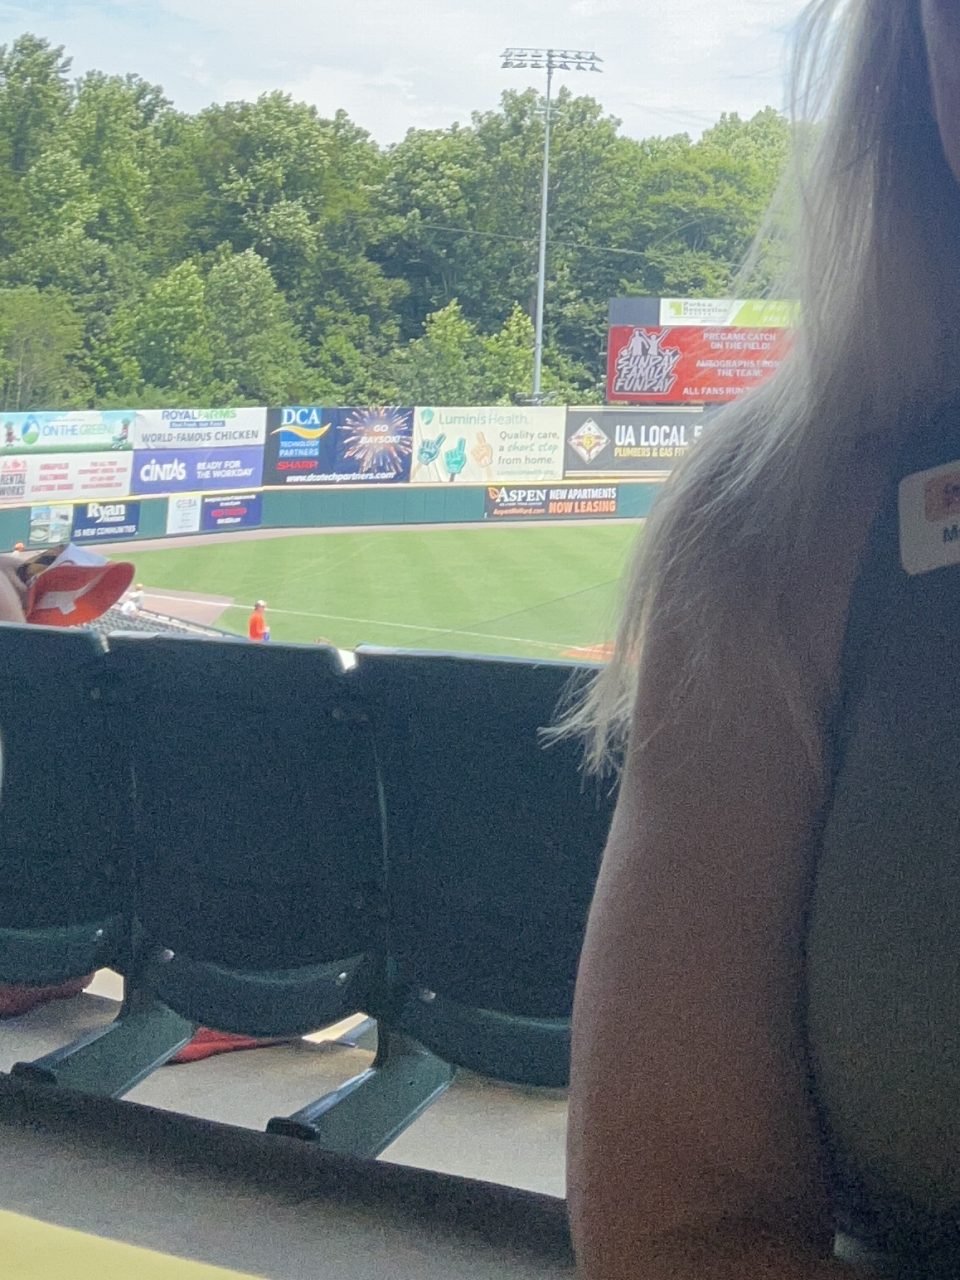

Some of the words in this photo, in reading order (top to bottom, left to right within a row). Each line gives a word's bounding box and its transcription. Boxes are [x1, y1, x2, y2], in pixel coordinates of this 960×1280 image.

[710, 342, 724, 350] ON
[725, 342, 743, 350] THE
[617, 354, 681, 369] SUNDAY
[619, 366, 674, 379] FAMILY
[717, 369, 734, 377] THE
[615, 377, 676, 392] FUNDAY
[682, 387, 700, 395] ALL
[701, 387, 724, 395] FANS
[161, 410, 198, 420] ROYAL
[198, 409, 237, 419] FARMS
[281, 408, 321, 425] DCA
[42, 425, 58, 436] ON
[60, 424, 78, 435] THE
[373, 424, 389, 432] GO
[141, 432, 212, 443] WORLD-FAMOUS
[214, 430, 259, 441] CHICKEN
[499, 431, 535, 441] Quality
[614, 425, 636, 446] UA
[640, 425, 688, 446] LOCAL
[280, 440, 320, 448] TECHNOLOGY
[279, 448, 319, 456] PARTNERS
[614, 447, 651, 457] PLUMBERS
[652, 448, 659, 457] &
[659, 447, 674, 457] GAS
[196, 461, 223, 471] READY
[224, 460, 242, 468] FOR
[275, 460, 319, 470] SHARP
[497, 455, 521, 465] from
[212, 468, 255, 478] WORKDAY
[496, 487, 547, 502] ASPEN
[549, 489, 567, 500] NEW
[568, 488, 617, 499] APARTMENTS
[549, 502, 573, 513] NOW
[574, 500, 616, 512] LEASING
[87, 502, 126, 523] Ryan
